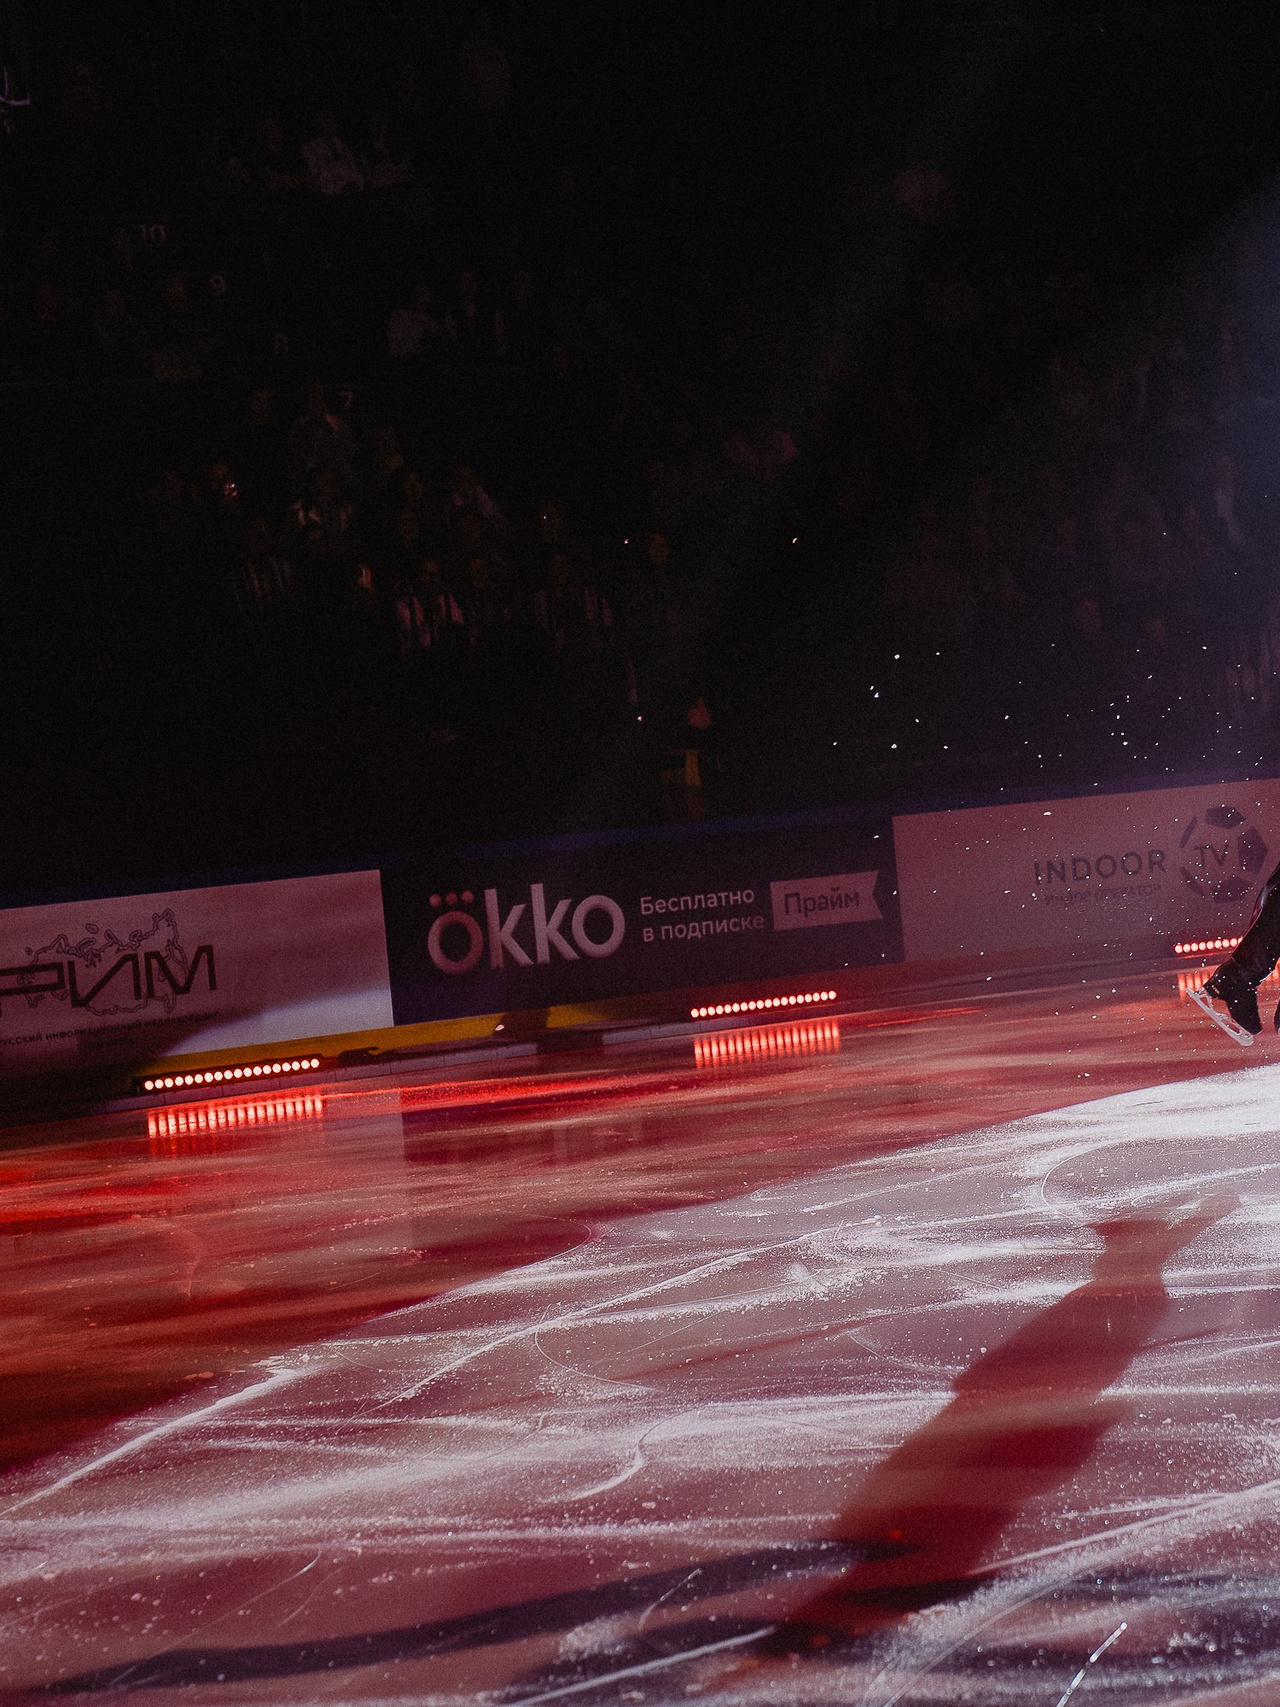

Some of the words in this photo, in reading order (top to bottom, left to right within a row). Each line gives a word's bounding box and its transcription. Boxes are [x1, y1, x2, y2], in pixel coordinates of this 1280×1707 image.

[208, 273, 228, 297] 9
[1033, 849, 1166, 886] INDOOR
[1193, 842, 1229, 869] TV
[640, 888, 755, 915] Бесплатно
[784, 886, 861, 919] Прайм
[643, 927, 655, 943] в
[661, 914, 765, 942] подписке
[0, 1034, 43, 1047] УССКИЙ
[45, 1019, 141, 1041] ИНФОРМАЦИОННЫЙ
